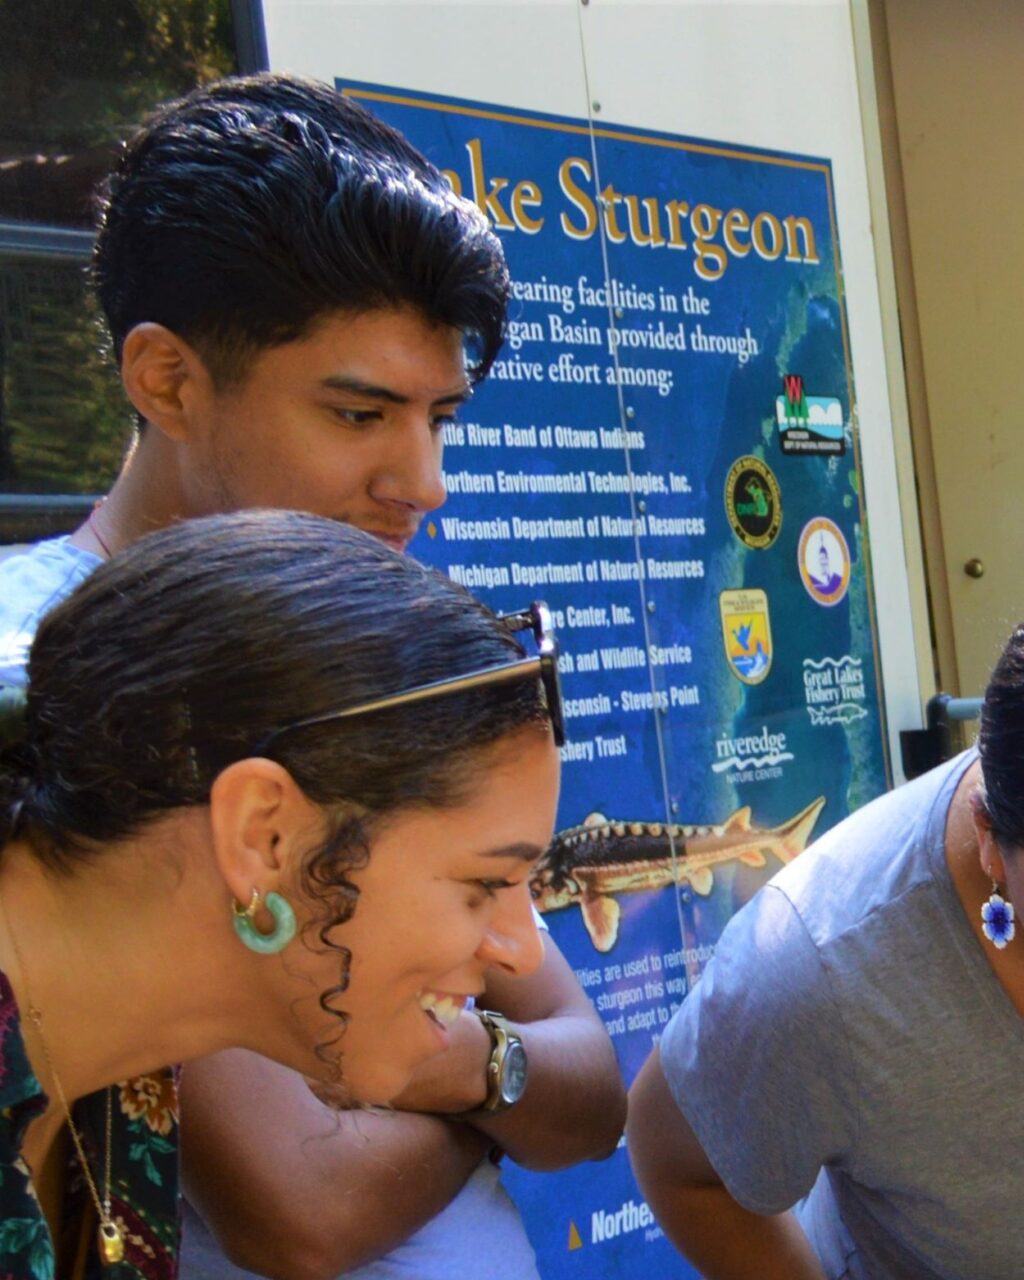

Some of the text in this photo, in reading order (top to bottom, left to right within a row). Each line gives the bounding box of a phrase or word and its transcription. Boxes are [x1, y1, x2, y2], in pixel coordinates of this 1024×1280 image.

[558, 156, 820, 282] Sturgeon
[577, 275, 656, 312] facilities
[658, 286, 678, 313] in
[682, 285, 711, 316] the
[548, 314, 602, 345] Basin
[606, 321, 687, 356] provided
[690, 323, 759, 364] through
[548, 352, 602, 384] effort
[605, 366, 675, 397] among:
[442, 422, 645, 449] ttle River Band of Ottawa Indians
[496, 470, 587, 494] Environmental
[587, 471, 669, 495] Technologies,
[669, 471, 693, 493] Inc.
[440, 515, 706, 542] Wisconsin Department of Natural Resources
[448, 558, 705, 589] Michigan Department of Natural Resources
[566, 605, 610, 629] Center,
[611, 603, 636, 626] Inc.
[558, 643, 692, 674] sh and Wildlife Service
[804, 665, 864, 687] Great Lakes
[620, 689, 669, 713] Stevens
[669, 684, 700, 707] Point
[805, 682, 866, 705] Fishery Trust
[558, 734, 628, 762] shery Trust
[716, 725, 787, 758] riveredge
[604, 966, 622, 982] are
[623, 956, 650, 978] used
[649, 954, 663, 972] to
[664, 944, 715, 968] reintroduc
[597, 986, 643, 1012] sturgeon
[644, 980, 665, 1000] this
[666, 978, 686, 996] way
[606, 1015, 626, 1036] and
[627, 1009, 657, 1031] adapt
[657, 1007, 670, 1023] to
